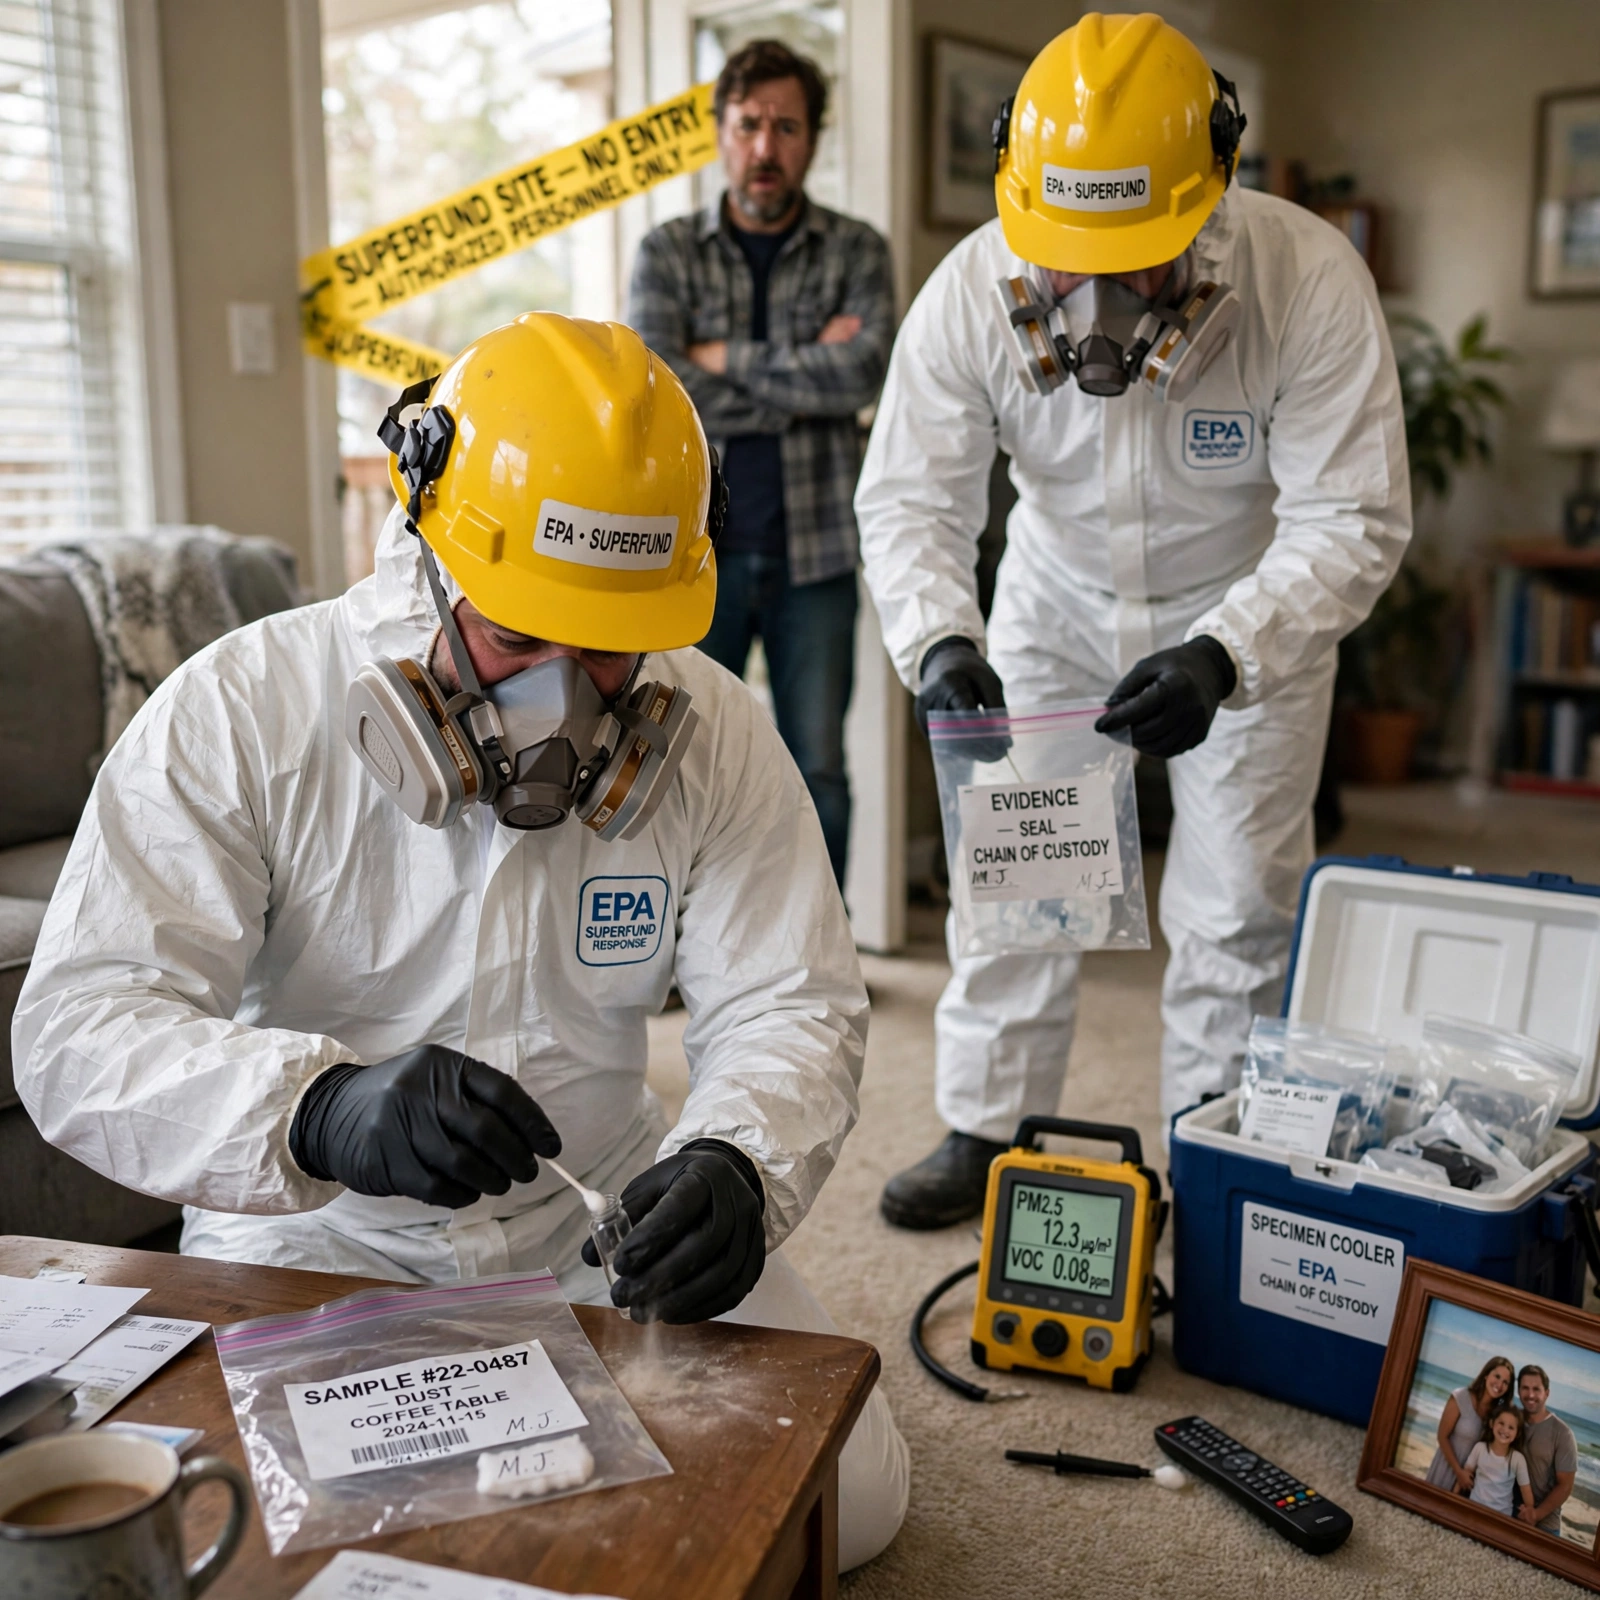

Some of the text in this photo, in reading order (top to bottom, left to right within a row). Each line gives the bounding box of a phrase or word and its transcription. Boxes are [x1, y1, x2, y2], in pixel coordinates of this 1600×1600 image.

[336, 97, 702, 285] SUPERFUND SITE NO ENTRY
[1046, 177, 1146, 199] EPA SUPERFUND
[377, 148, 682, 304] AUTHORIZED PERSONNEL ONLY
[1193, 420, 1244, 440] EPA
[544, 517, 673, 555] EPA SUPERFUND
[991, 787, 1079, 811] EVIDENCE
[1019, 819, 1057, 837] SEAL
[974, 839, 1109, 864] CHAIN OF CUSTODY
[592, 892, 655, 921] EPA
[585, 923, 656, 938] SUPERFUND
[592, 938, 648, 951] RESPONSE
[1016, 1190, 1063, 1216] PM2.5
[1044, 1218, 1080, 1248] 12.3
[1251, 1213, 1395, 1267] SPECIMEN COOLER
[1011, 1247, 1110, 1289] VOC 0.08 ppm
[1298, 1258, 1337, 1285] EPA
[1260, 1273, 1296, 1294] CHAIN
[1300, 1285, 1316, 1299] OF
[1319, 1290, 1379, 1318] CUSTODY
[304, 1351, 529, 1405] SAMPLE #22-0487
[350, 1390, 510, 1429] COFFEE TABLE
[395, 1386, 452, 1406] DUST
[382, 1409, 487, 1438] 2024-11-15
